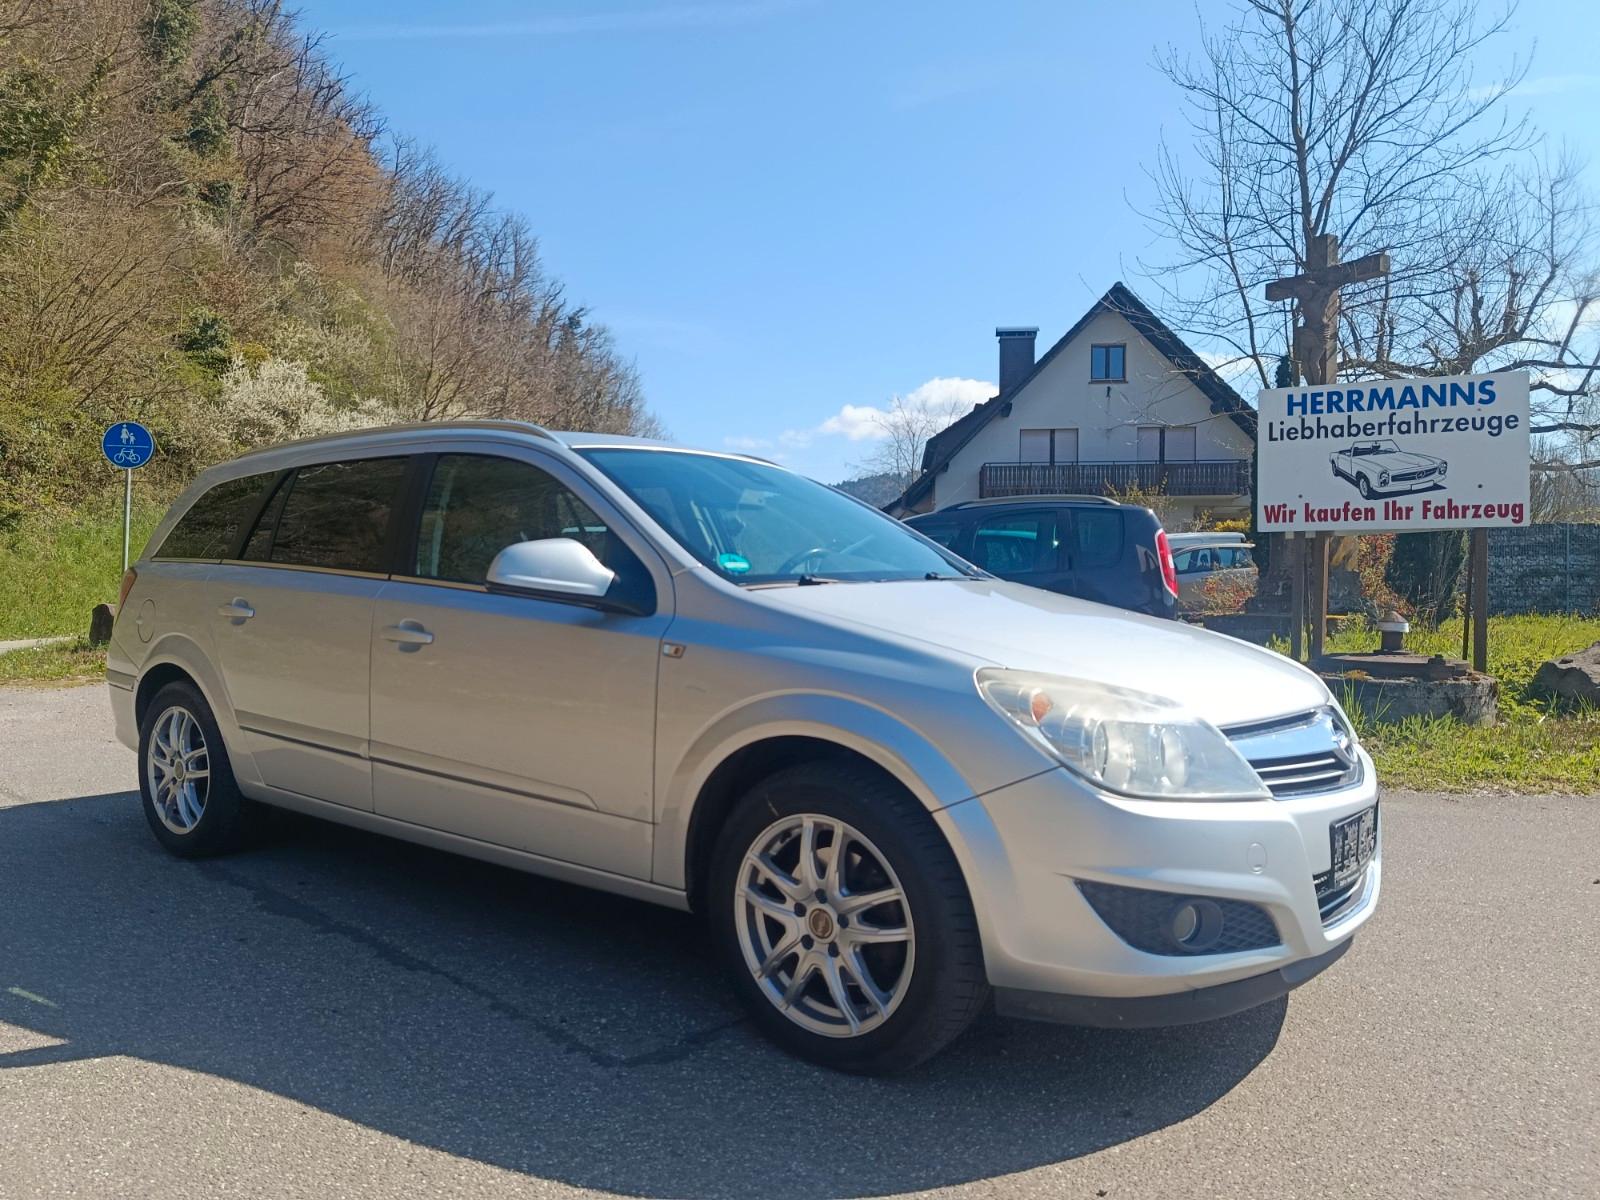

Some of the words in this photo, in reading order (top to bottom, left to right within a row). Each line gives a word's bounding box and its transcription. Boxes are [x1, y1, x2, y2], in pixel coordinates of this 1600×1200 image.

[1287, 380, 1496, 416] HERRMANNS
[1268, 411, 1519, 441] Liebhaberfahrzeuge
[1264, 503, 1296, 523] Wir
[1304, 502, 1375, 523] kaufen
[1384, 500, 1414, 521] Ihr
[1422, 499, 1524, 524] Fahrzeug
